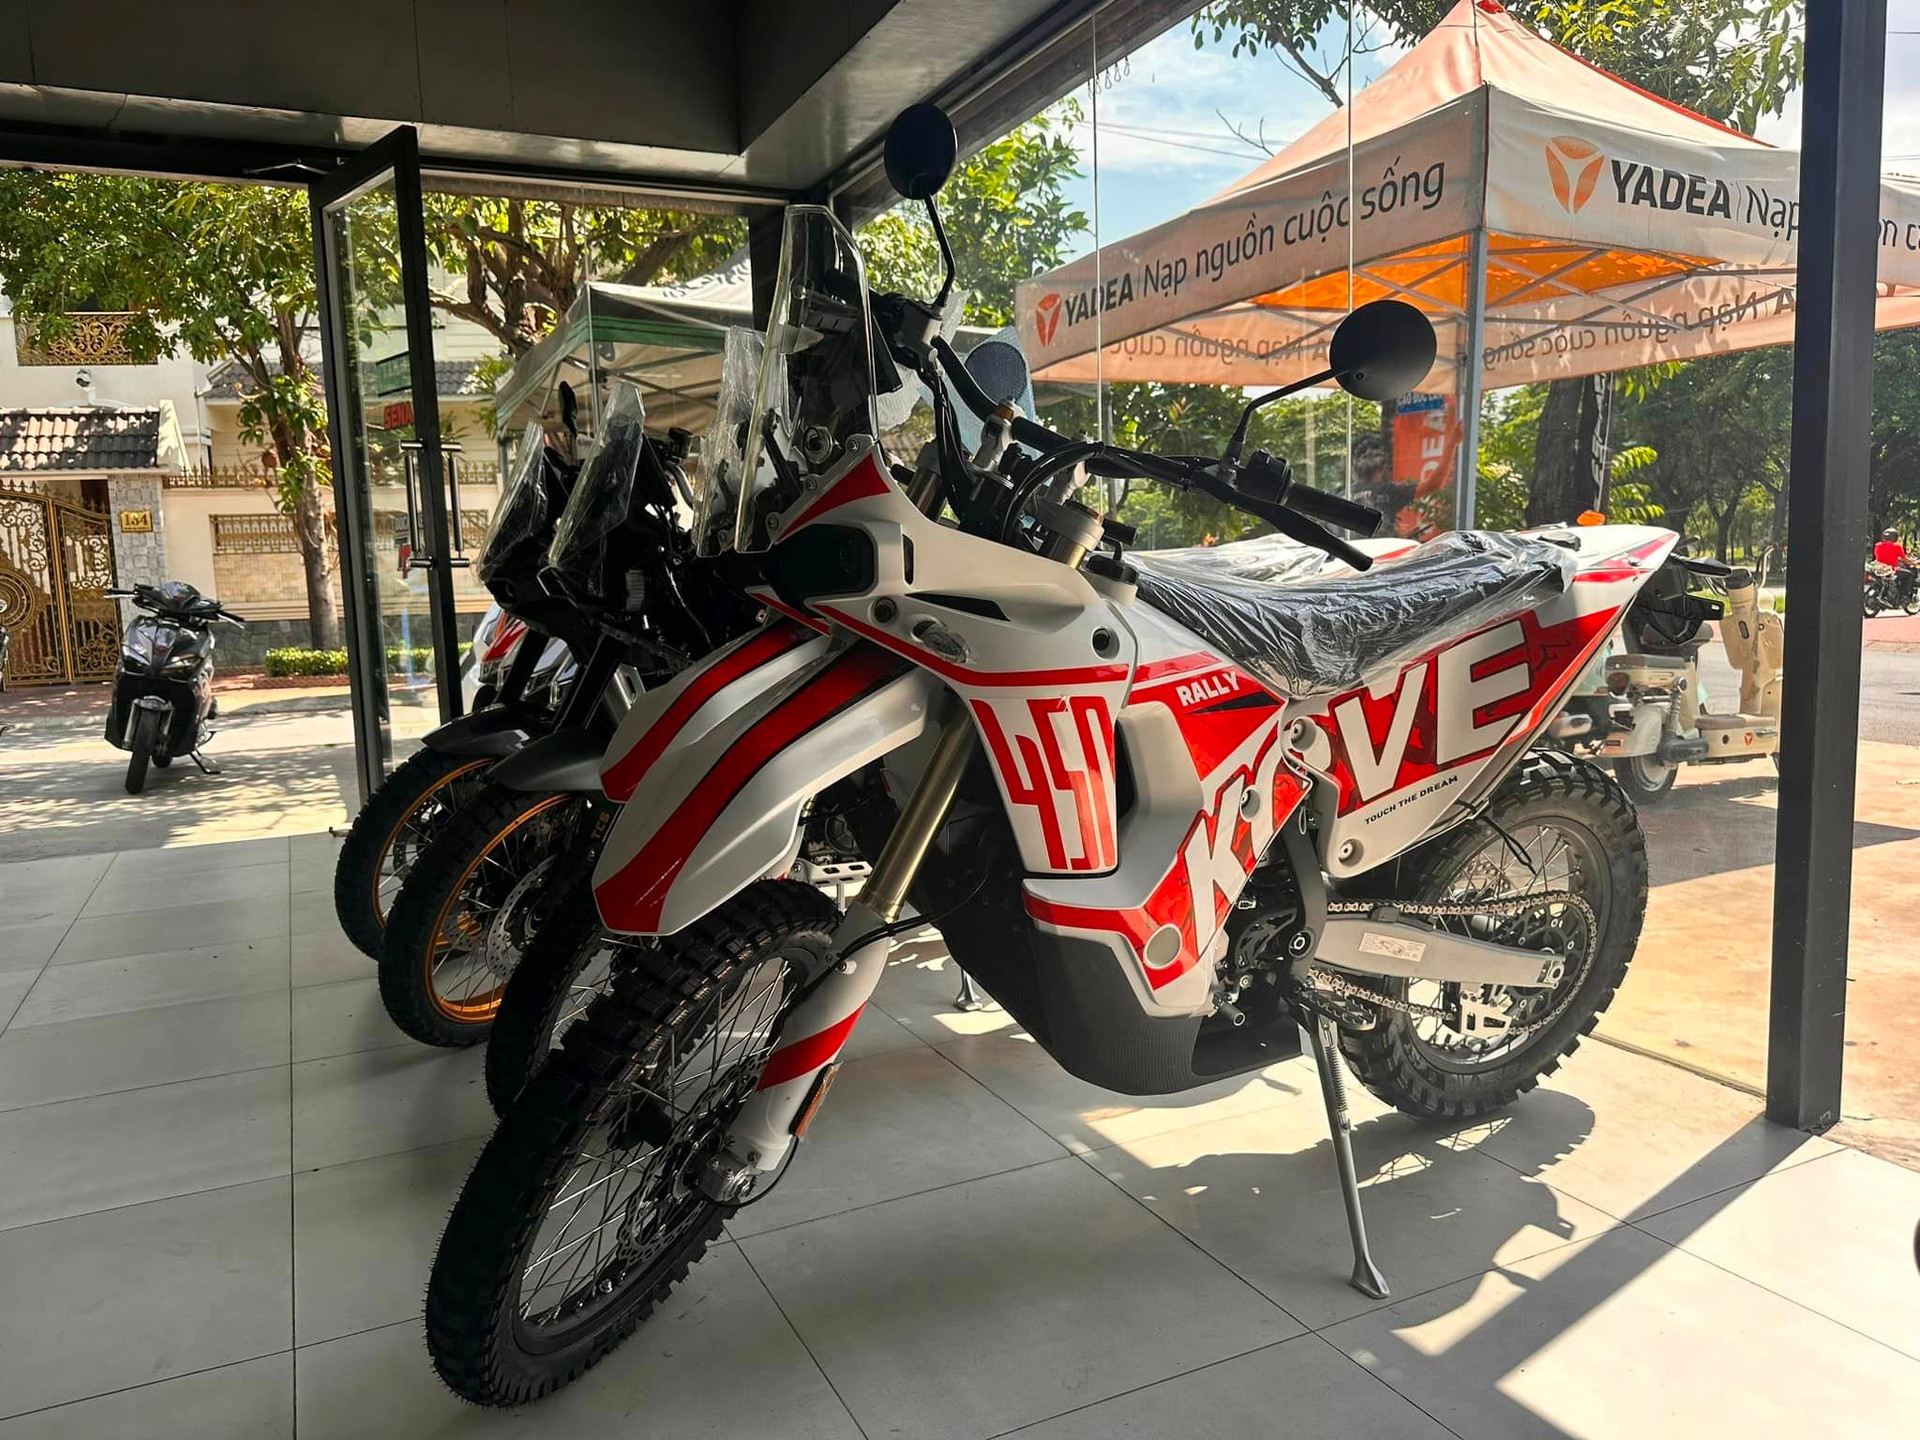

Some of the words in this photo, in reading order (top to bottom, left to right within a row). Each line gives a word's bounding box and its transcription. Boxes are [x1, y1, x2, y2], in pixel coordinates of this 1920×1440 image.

[1611, 159, 1731, 220] YADEA
[1065, 272, 1134, 327] YADEA
[1143, 258, 1187, 298] Nạp
[1195, 212, 1275, 283] nguồn
[1283, 190, 1350, 244] cuộc
[1360, 156, 1445, 221] sống
[1175, 671, 1240, 707] RALLY
[970, 696, 1116, 870] 450
[1365, 804, 1396, 825] TOUCH
[1398, 793, 1418, 808] THE
[1419, 775, 1458, 797] DREAM
